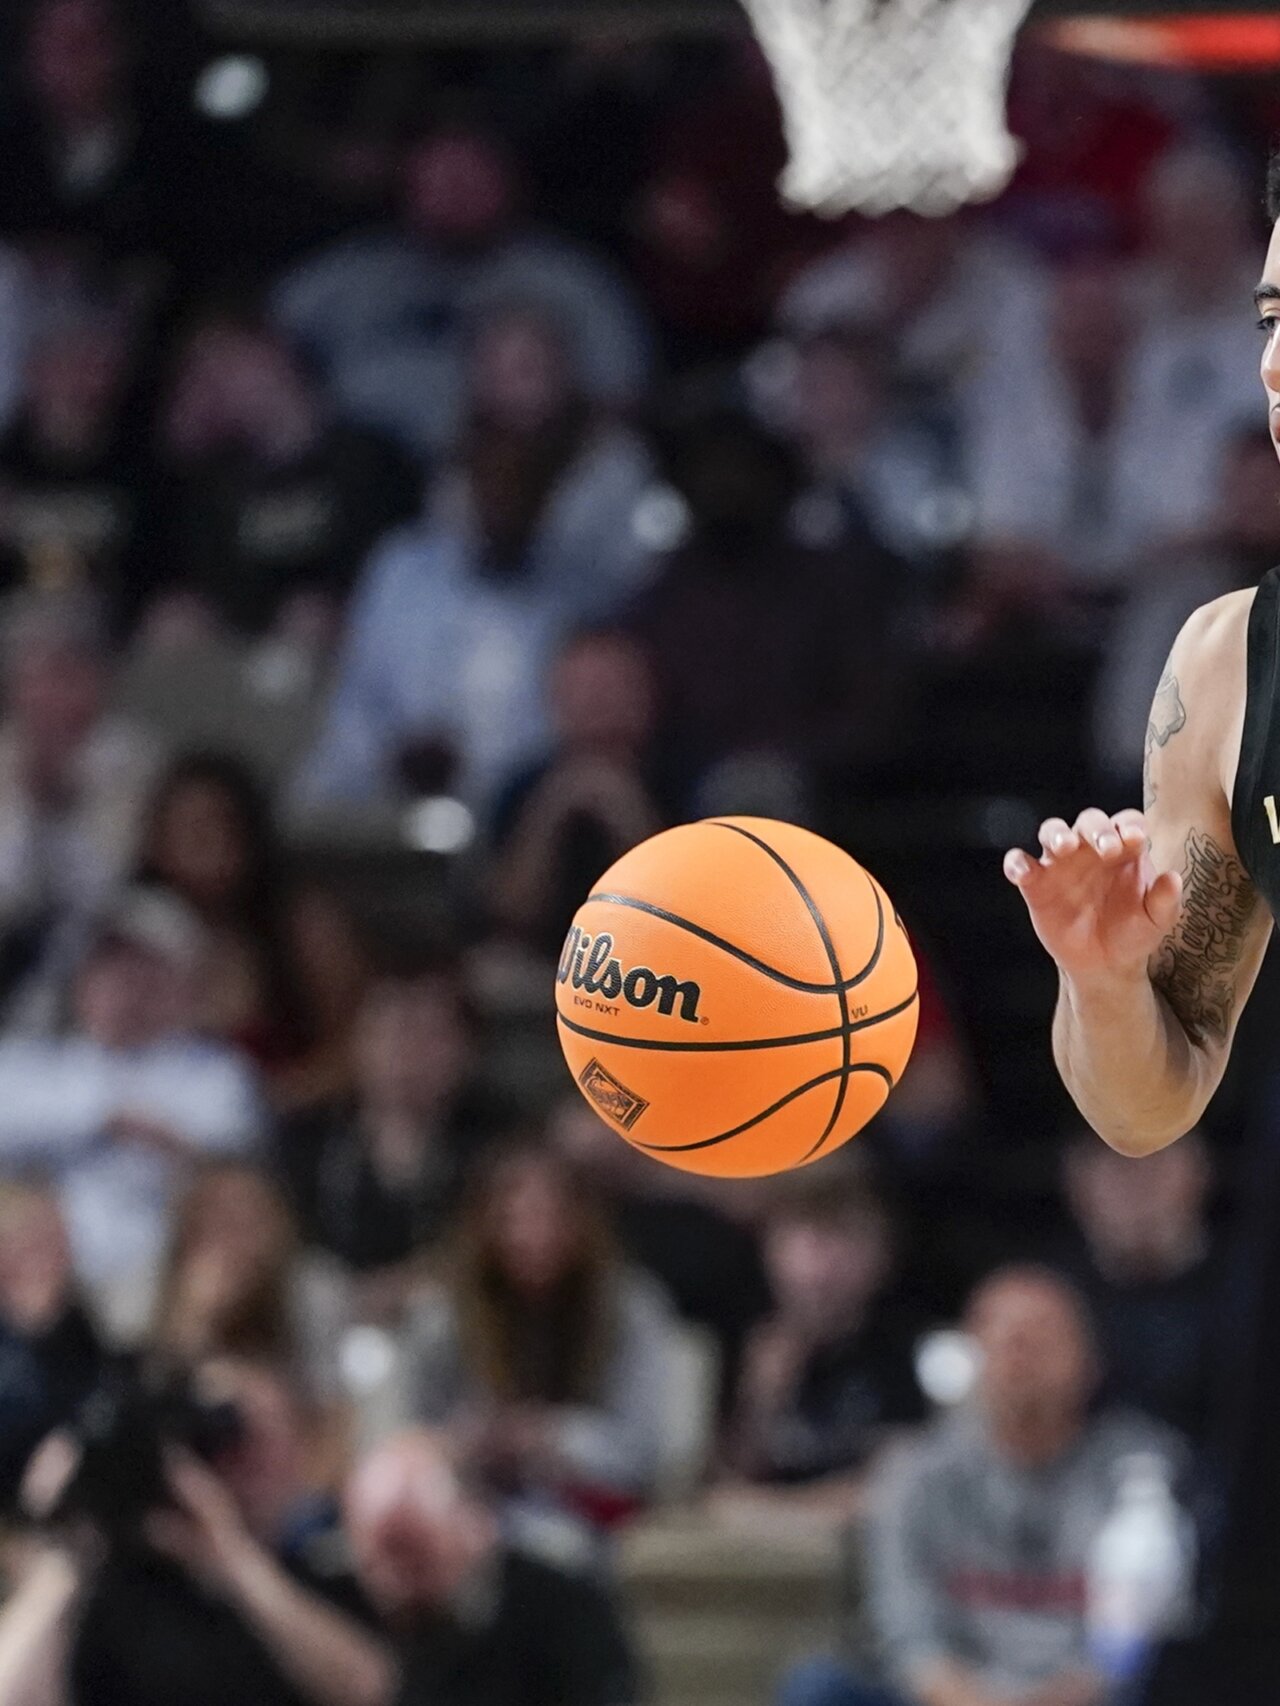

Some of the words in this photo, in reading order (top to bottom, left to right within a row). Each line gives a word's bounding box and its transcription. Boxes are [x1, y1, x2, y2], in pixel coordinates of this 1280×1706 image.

[574, 996, 592, 1010] EVO
[595, 1002, 620, 1017] NXT
[851, 1004, 868, 1019] VU
